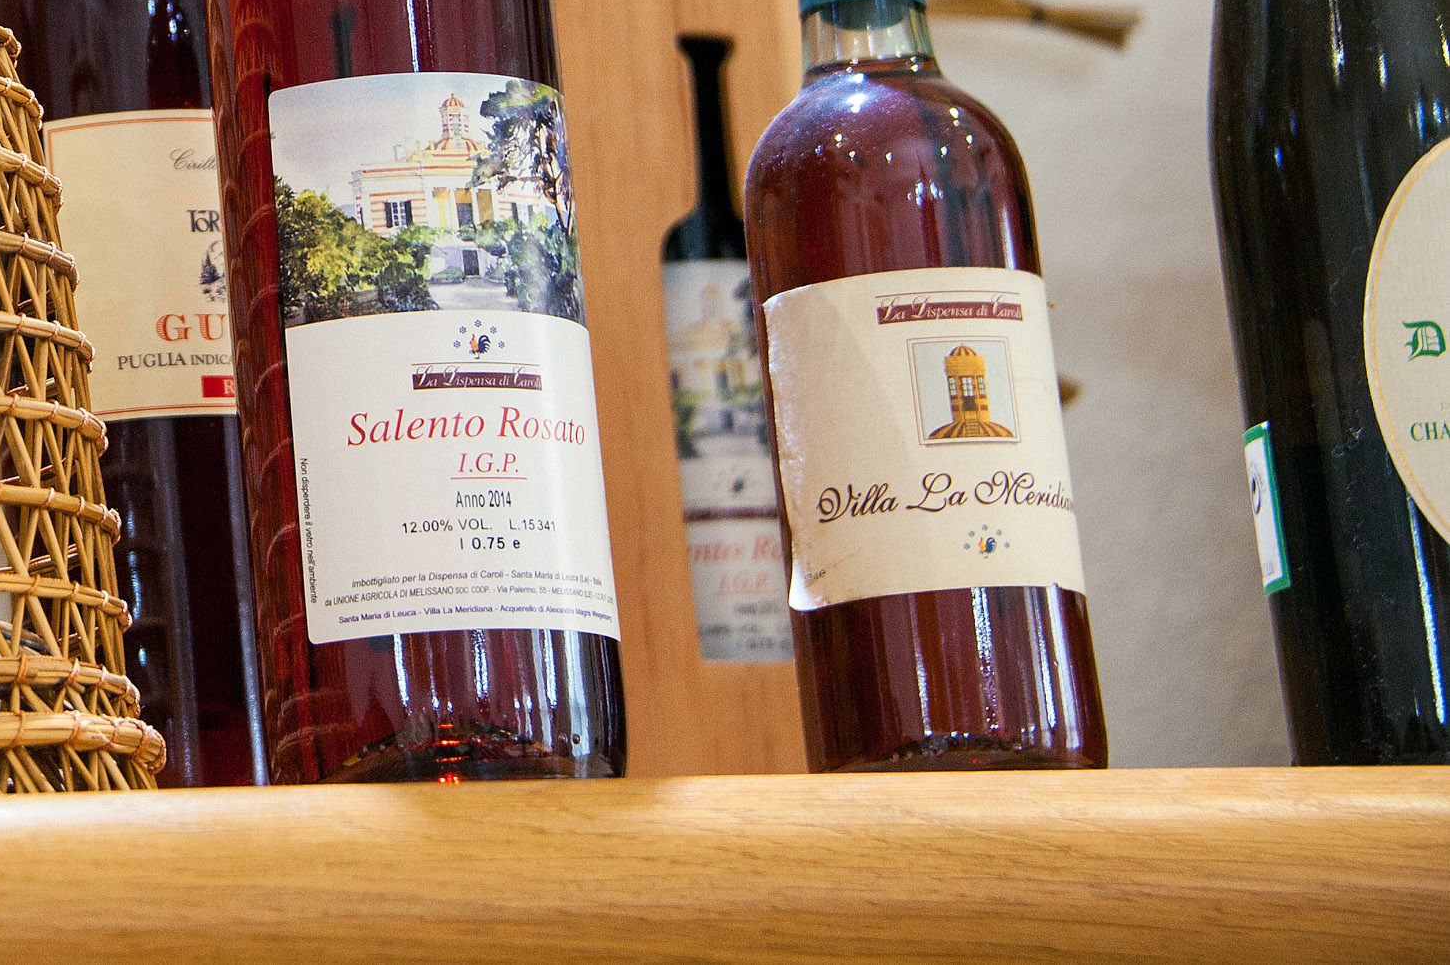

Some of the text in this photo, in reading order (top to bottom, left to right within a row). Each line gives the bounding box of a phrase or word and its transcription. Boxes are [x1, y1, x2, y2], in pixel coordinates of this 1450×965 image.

[186, 209, 221, 233] TOR
[881, 296, 905, 321] La
[911, 295, 973, 320] Dispensa
[976, 303, 989, 317] di
[155, 313, 228, 342] GU
[1402, 320, 1447, 362] D
[117, 352, 186, 370] PUGLIA
[443, 365, 497, 388] Dispensa
[499, 375, 509, 386] di
[347, 406, 585, 447] Salento Rosato
[1410, 419, 1450, 443] CHA
[300, 458, 308, 475] Non
[457, 452, 519, 473] I.G.P.
[301, 476, 311, 520] disperdere
[456, 490, 512, 508] Anno 2014
[817, 470, 1075, 523] Villa La Meridia
[402, 519, 454, 534] 12.00%
[458, 518, 493, 531] VOL.
[471, 537, 506, 551] 0.75
[351, 574, 400, 588] imbottigliato
[402, 574, 417, 585] per
[418, 573, 426, 582] la
[428, 572, 468, 582] Dispensa
[470, 570, 478, 579] di
[480, 570, 504, 579] Caroli
[511, 570, 533, 579] Santa
[534, 571, 553, 580] Maria
[333, 595, 359, 606] UNIONE
[360, 591, 399, 602] AGRICOLA
[400, 588, 408, 598] DI
[409, 586, 454, 597] MELISSANO
[497, 585, 508, 594] Via
[338, 614, 359, 624] Santa
[361, 612, 382, 622] Maria
[384, 611, 390, 619] di
[392, 609, 417, 618] Leuca
[423, 606, 441, 615] Villa
[442, 606, 453, 614] La
[454, 605, 493, 614] Meridiana
